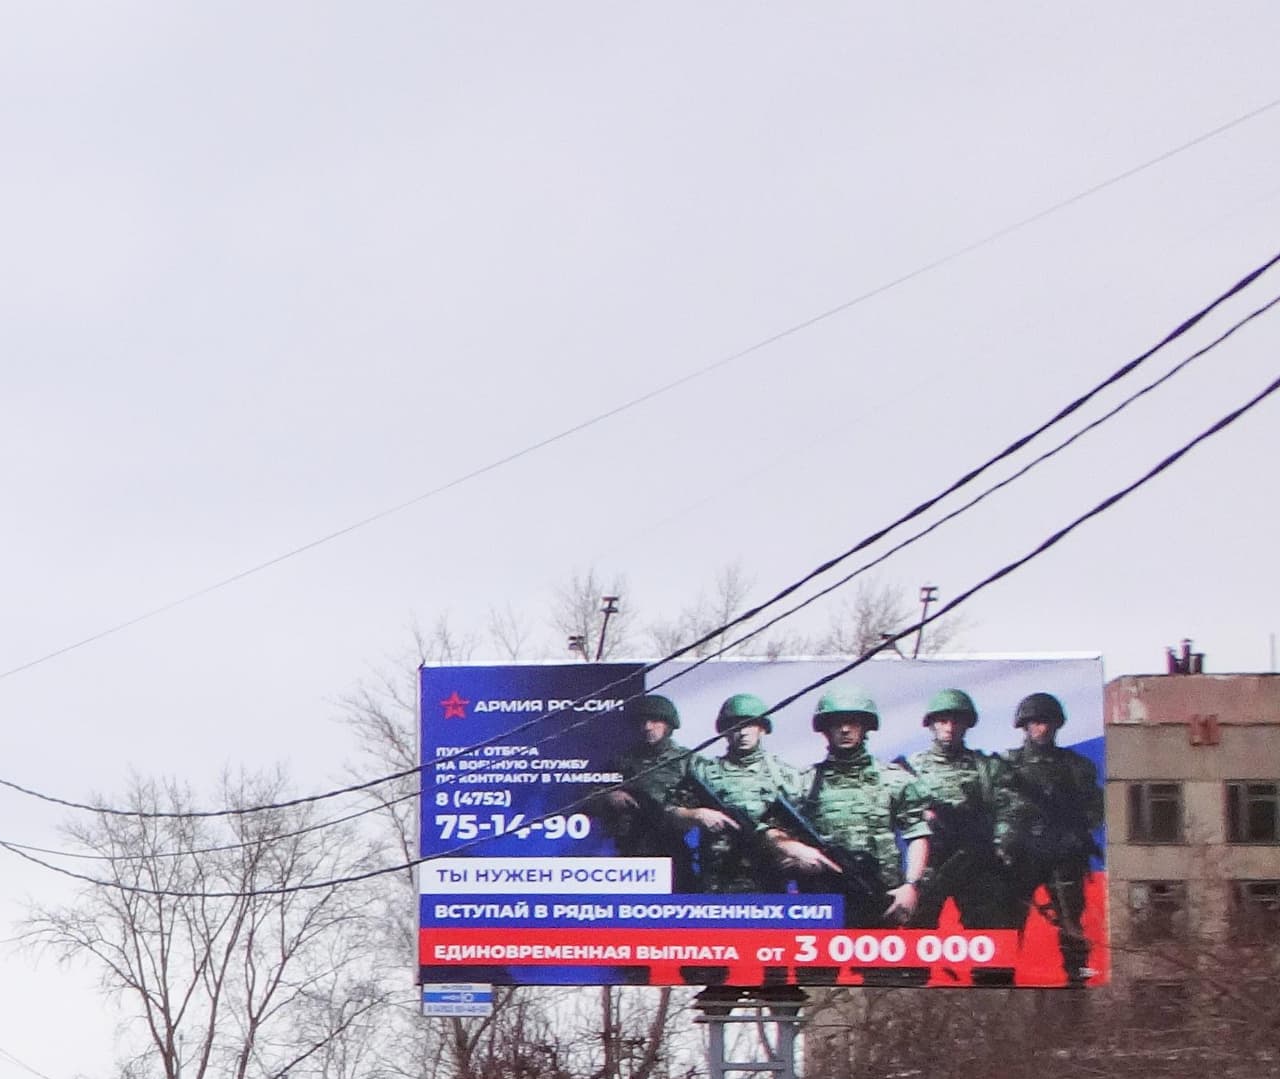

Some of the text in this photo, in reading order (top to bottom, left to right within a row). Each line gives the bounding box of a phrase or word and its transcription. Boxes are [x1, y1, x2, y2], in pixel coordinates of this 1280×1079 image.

[474, 700, 542, 712] АРМИЯ
[436, 760, 456, 771] НА
[531, 760, 589, 769] СЛУЖБУ
[436, 772, 623, 784] ПО КОНТРАКТУ В ТАМБОВЕ:
[435, 790, 511, 808] 8 (4752)
[435, 813, 590, 840] 75-14-90
[437, 868, 656, 882] ТЫ НУЖЕН РОССИИ!
[435, 902, 832, 921] ВСТУПАЙ В РЯДЫ ВООРУЖЕННЫХ СИЛ
[435, 945, 631, 960] ЕДИНОВРЕМЕННАЯ
[636, 945, 739, 960] ВЫПЛАТА
[794, 935, 818, 962] 3
[828, 935, 905, 962] 000
[916, 935, 995, 962] 000
